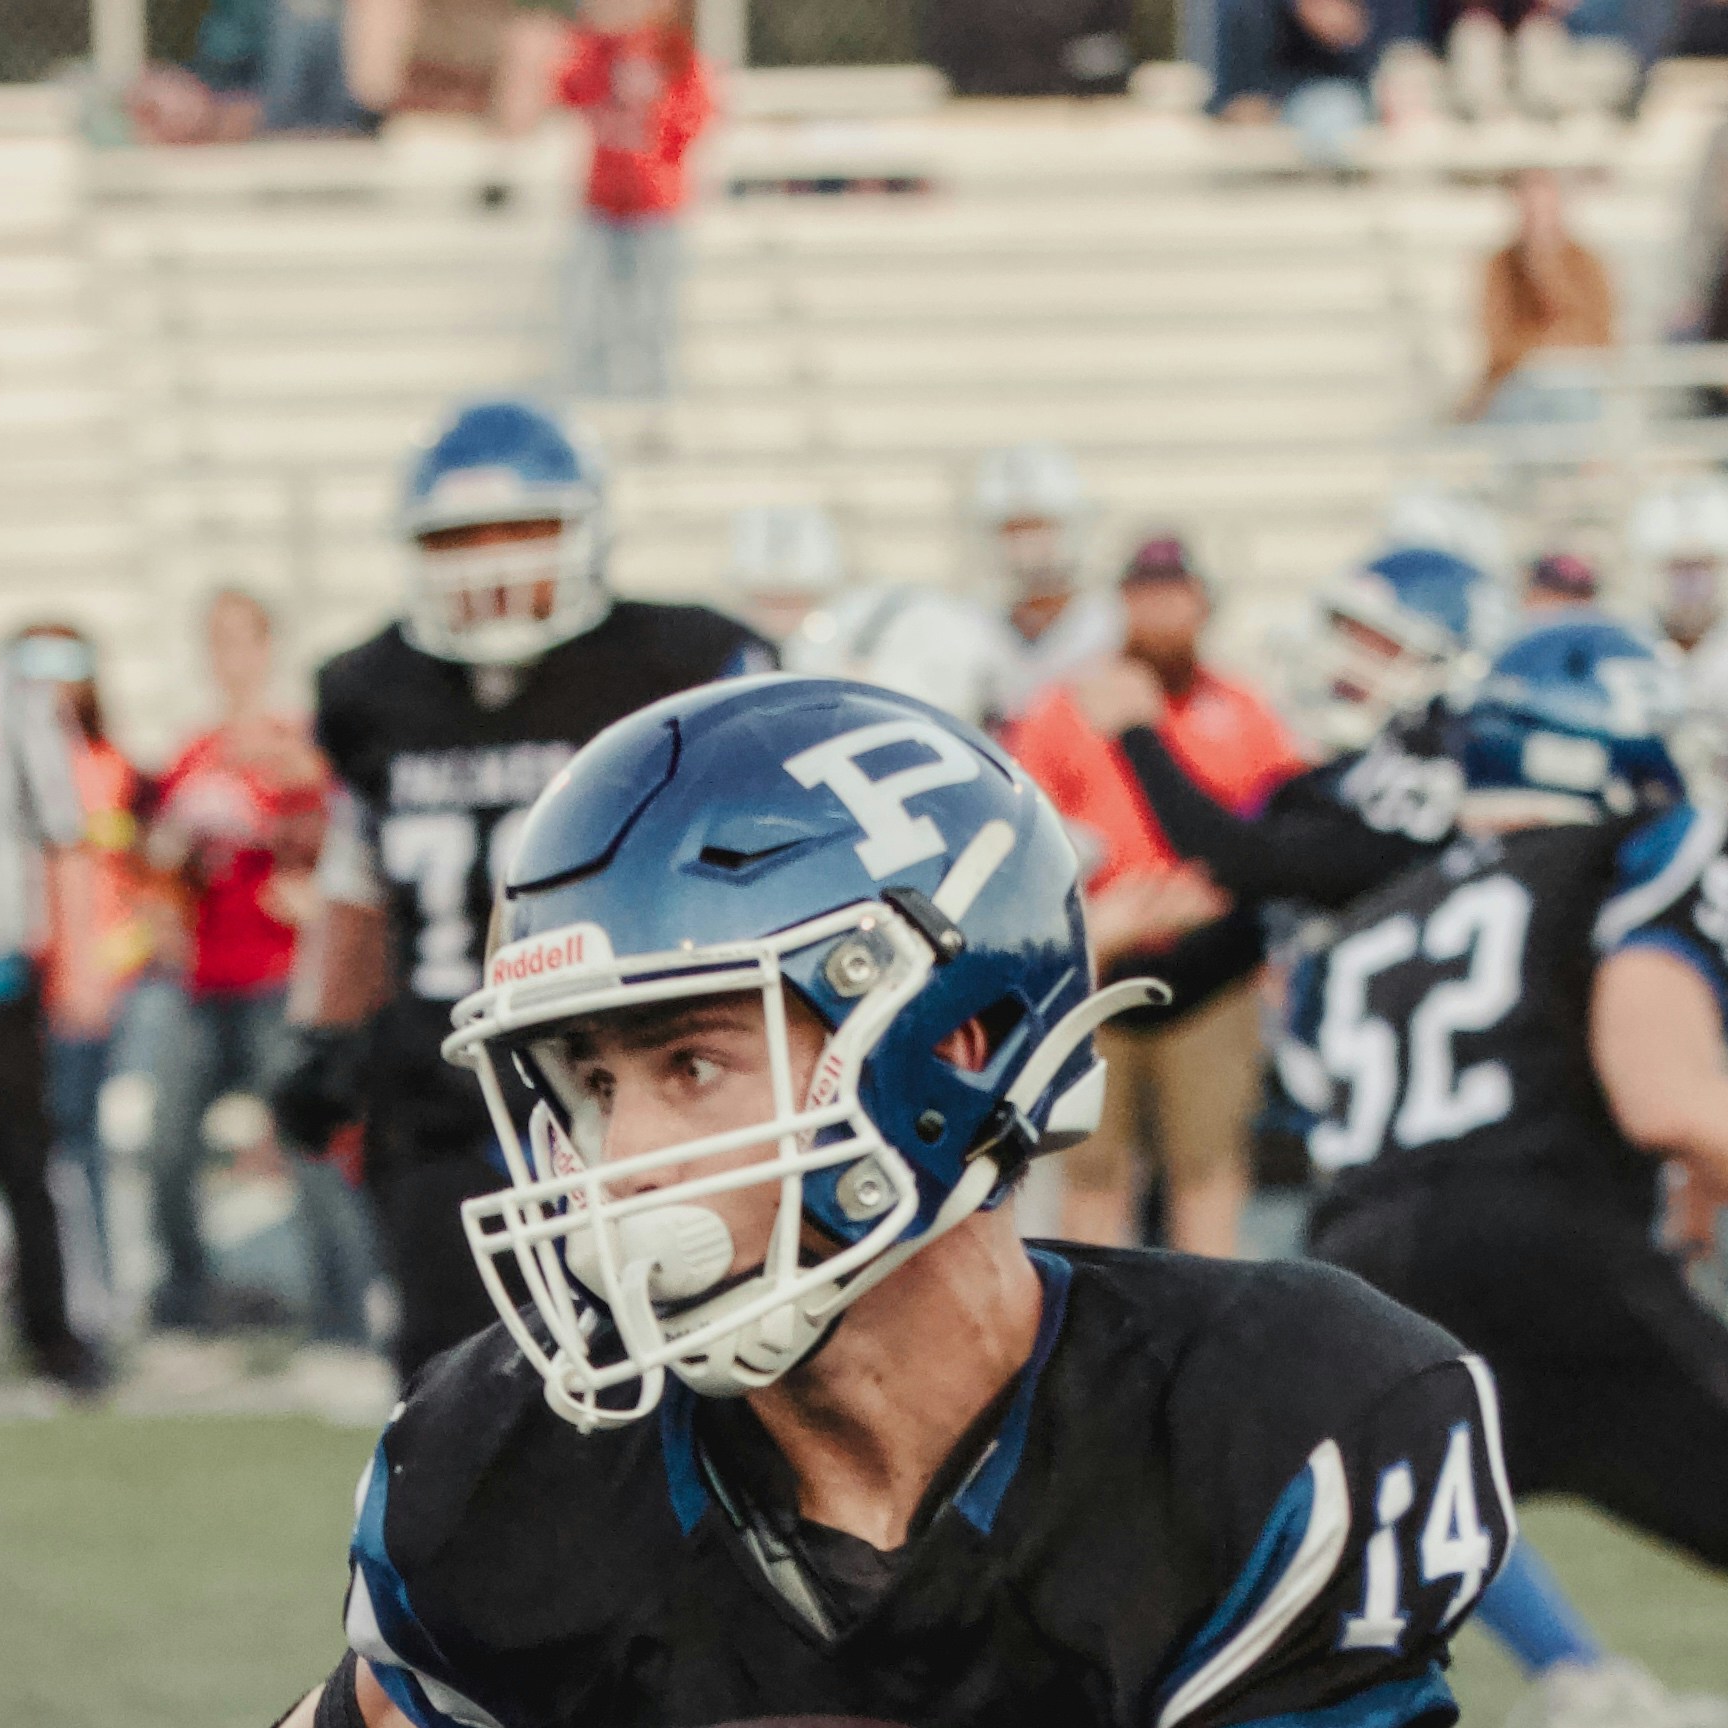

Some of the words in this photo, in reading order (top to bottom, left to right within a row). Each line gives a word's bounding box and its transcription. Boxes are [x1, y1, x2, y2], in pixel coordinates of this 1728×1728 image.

[780, 719, 982, 882] P
[492, 933, 584, 988] Riddell
[1307, 873, 1534, 1172] 52
[1336, 1420, 1494, 1655] 14
